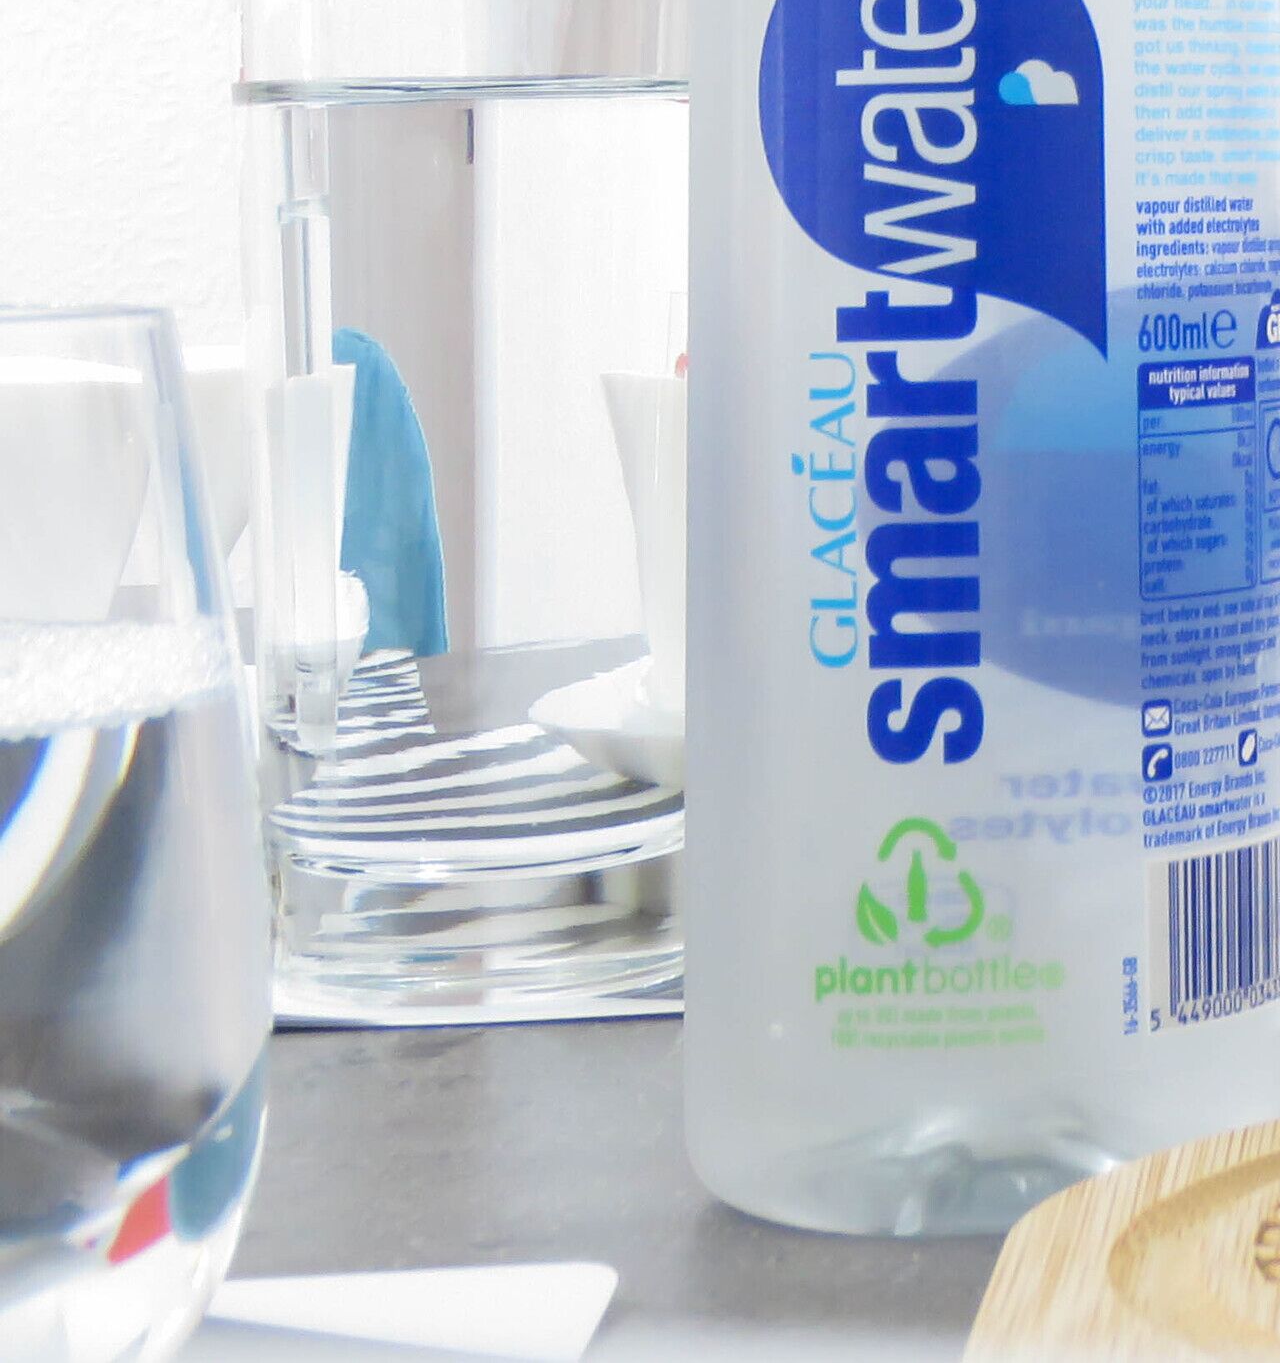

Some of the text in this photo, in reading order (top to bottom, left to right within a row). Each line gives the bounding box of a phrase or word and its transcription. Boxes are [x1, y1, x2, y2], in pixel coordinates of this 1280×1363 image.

[1136, 196, 1254, 217] vapour distilled water
[1136, 219, 1166, 236] with
[1169, 218, 1204, 235] added
[1136, 240, 1210, 260] ingredients:
[1149, 366, 1196, 385] nutrition
[1199, 363, 1250, 382] information
[1169, 383, 1237, 405] typical values
[791, 351, 860, 669] GLACÉAU
[1188, 779, 1223, 798] Energy
[1143, 827, 1205, 850] trademark
